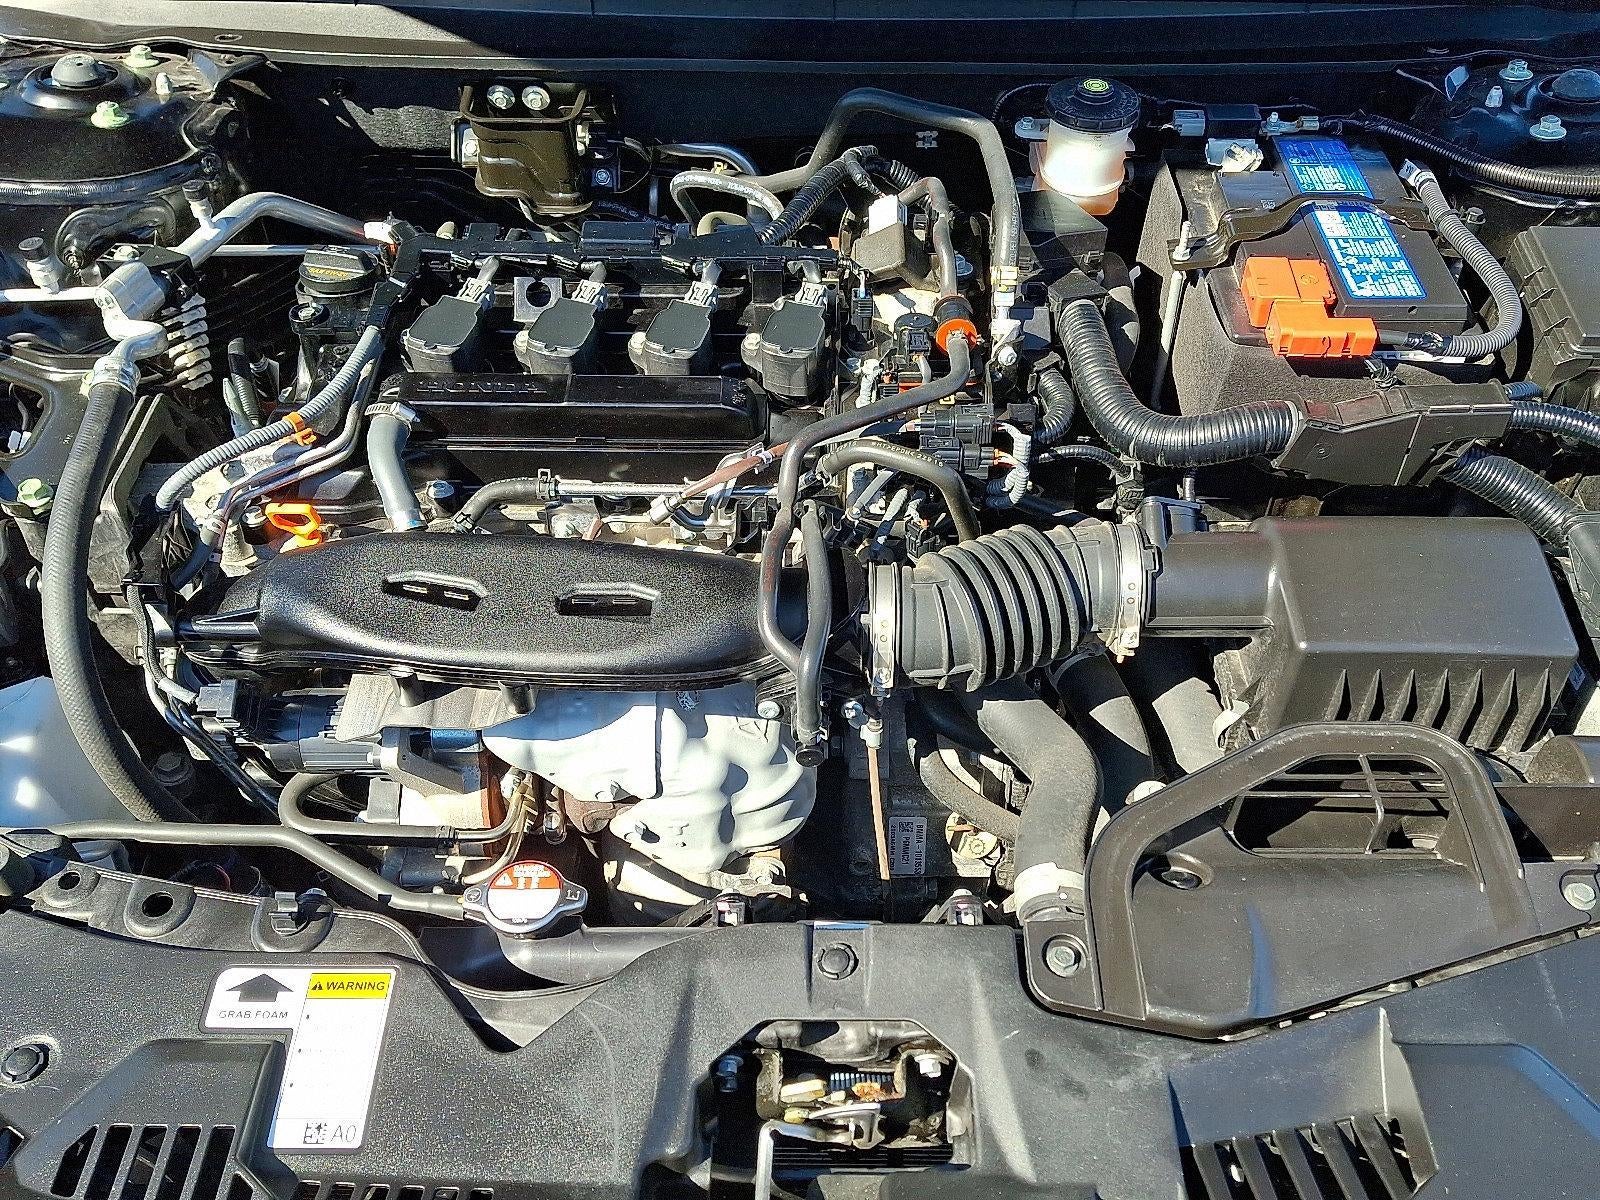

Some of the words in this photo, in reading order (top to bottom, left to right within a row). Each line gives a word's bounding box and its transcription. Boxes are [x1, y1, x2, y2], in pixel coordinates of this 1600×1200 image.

[416, 381, 547, 394] HONDA
[325, 981, 385, 991] WARNING
[218, 1010, 251, 1019] GRAB
[254, 1011, 289, 1019] FOAM
